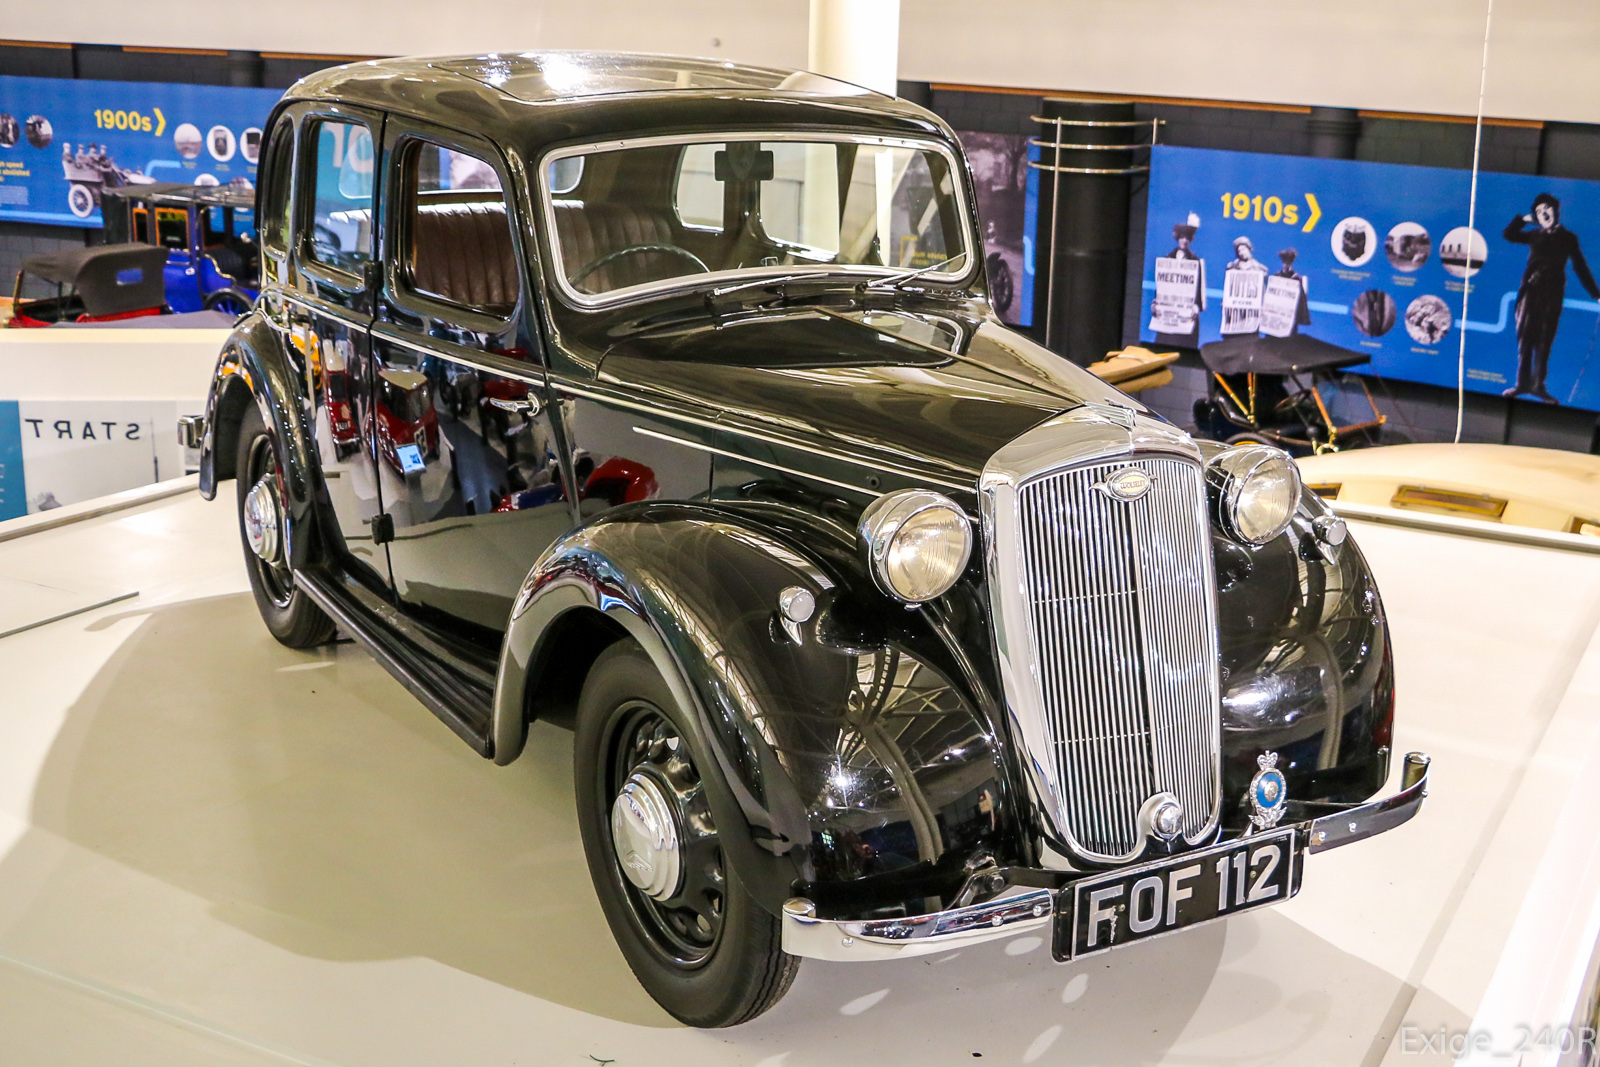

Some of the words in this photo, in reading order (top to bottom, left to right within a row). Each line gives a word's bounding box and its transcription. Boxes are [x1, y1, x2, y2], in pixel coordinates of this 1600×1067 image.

[94, 109, 153, 132] 1900s
[1220, 192, 1299, 225] 1910s
[1157, 272, 1195, 285] MEETING
[1229, 272, 1259, 298] VOTES
[1087, 863, 1201, 947] FOF
[1216, 844, 1281, 911] 112
